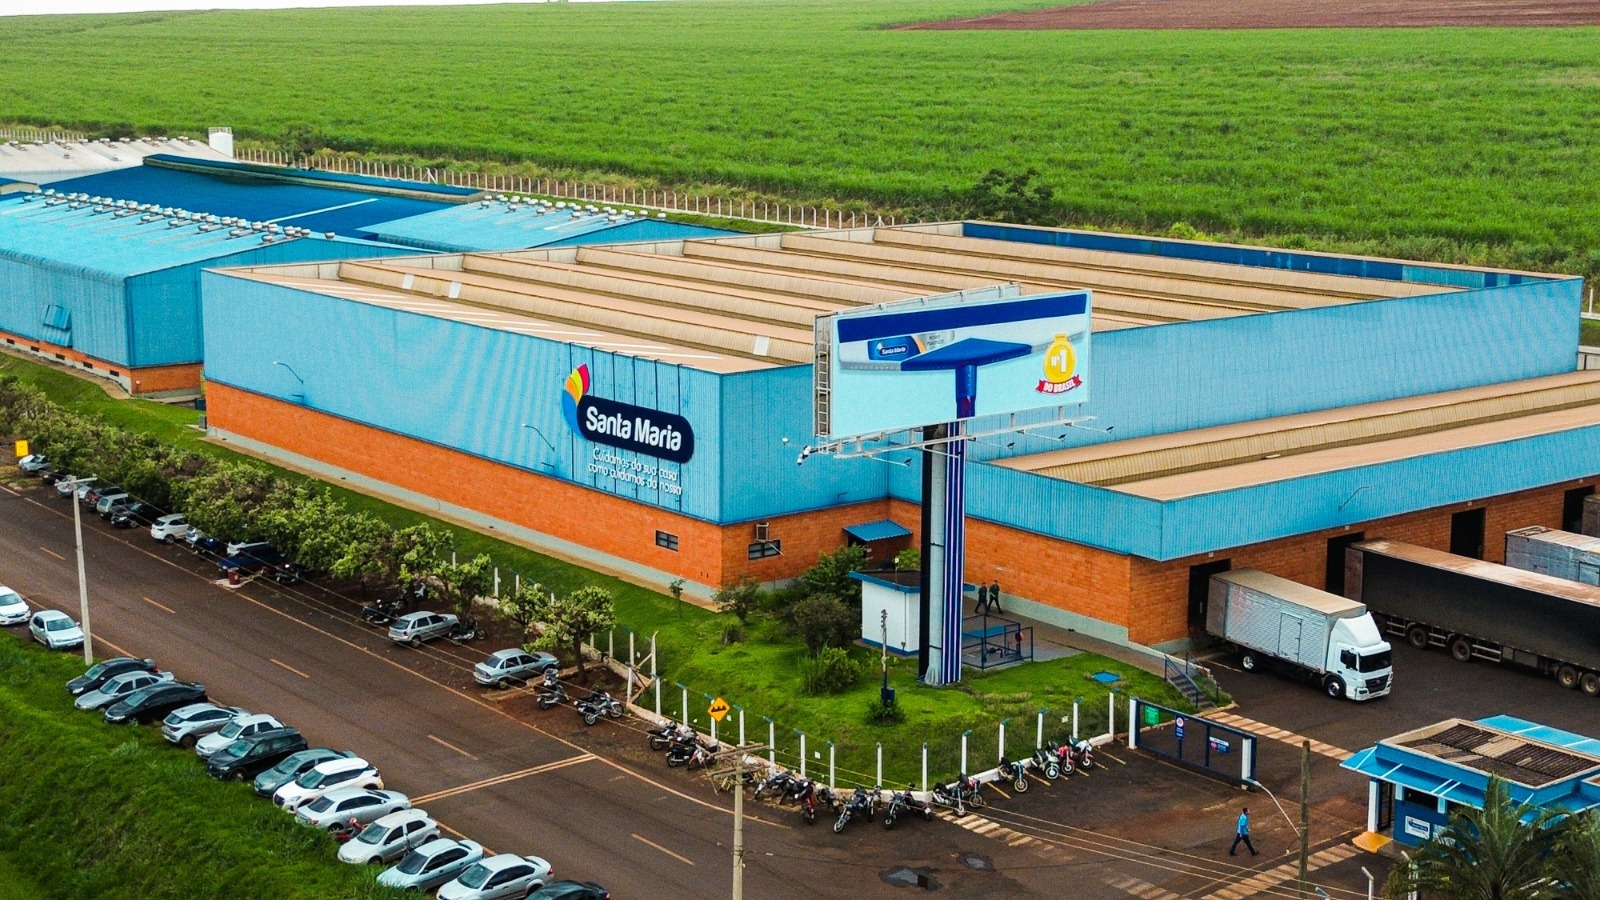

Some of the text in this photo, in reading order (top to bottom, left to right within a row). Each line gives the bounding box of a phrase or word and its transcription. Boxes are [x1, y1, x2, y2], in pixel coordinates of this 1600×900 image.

[1043, 378, 1076, 392] DO BRASIL
[586, 406, 682, 451] Santa Maria
[589, 463, 609, 476] como
[610, 468, 645, 486] cuidamos
[660, 482, 682, 495] nossa
[593, 447, 630, 468] Cuidamos
[644, 464, 656, 476] sua
[658, 468, 676, 480] casa
